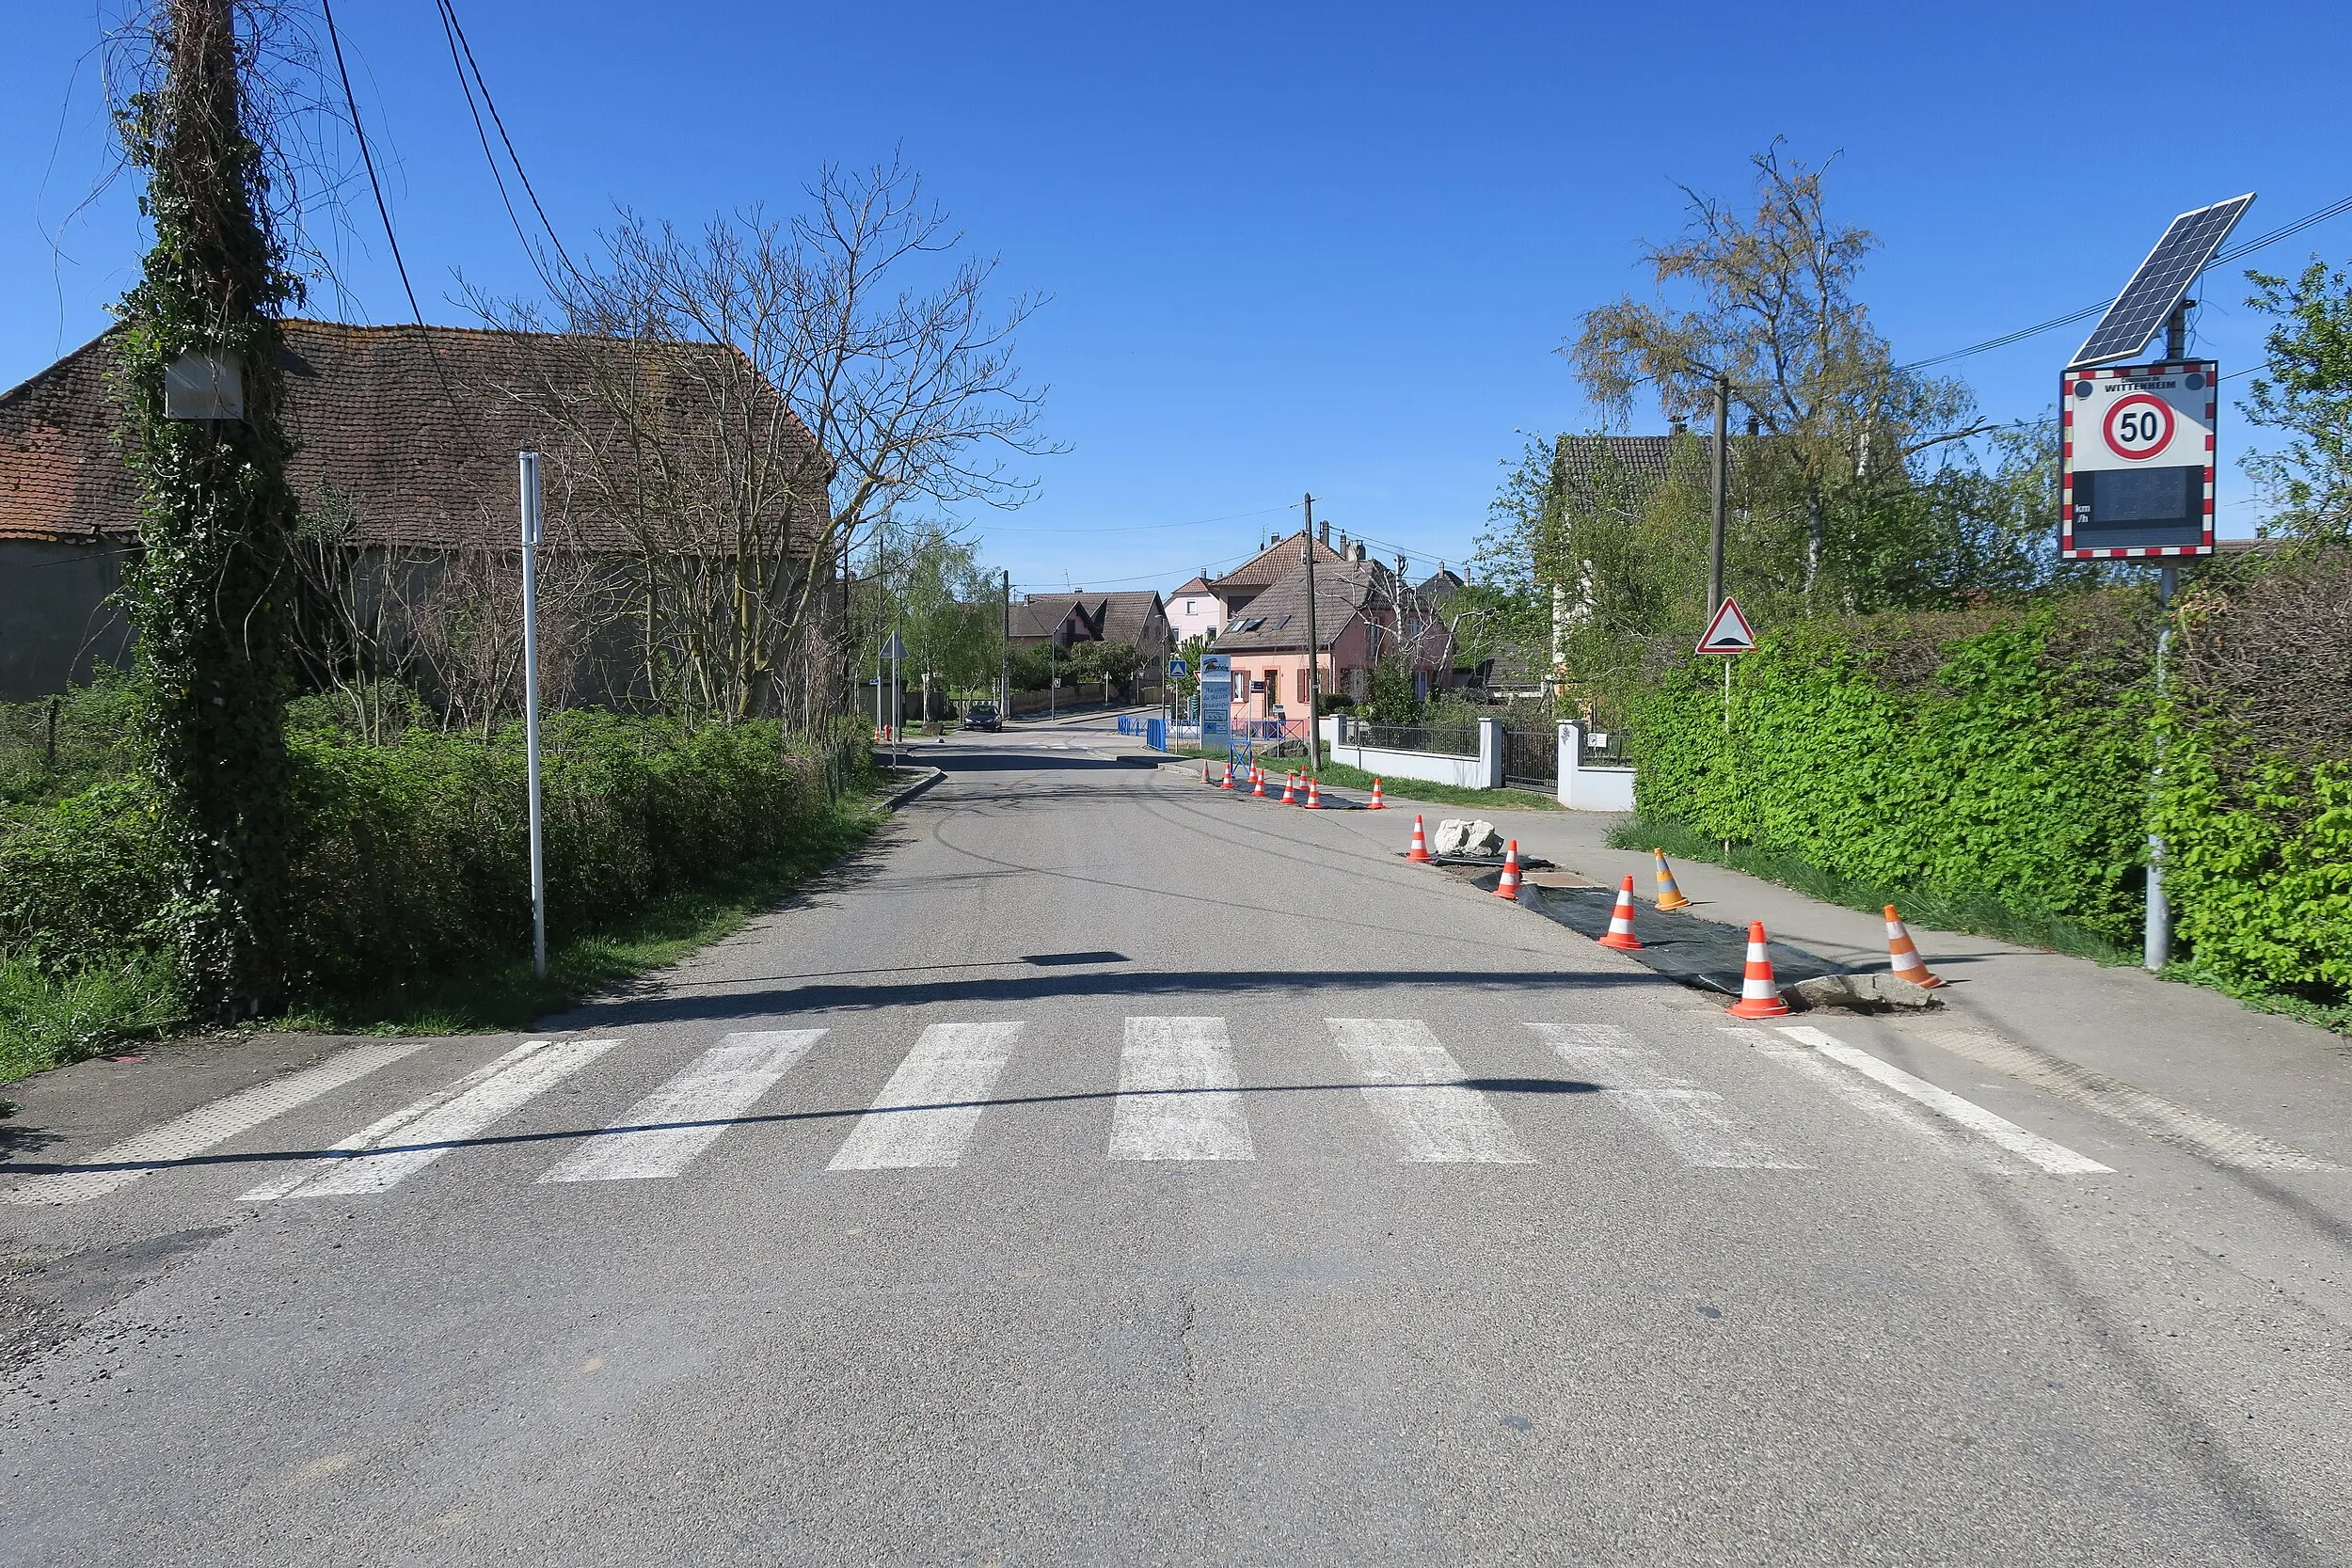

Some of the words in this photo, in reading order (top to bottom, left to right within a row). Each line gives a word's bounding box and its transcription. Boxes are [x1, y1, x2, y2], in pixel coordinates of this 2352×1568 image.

[2105, 380, 2176, 393] WITTENHEIM
[2121, 411, 2157, 442] 50
[2074, 503, 2091, 513] km
[2077, 514, 2089, 523] /h
